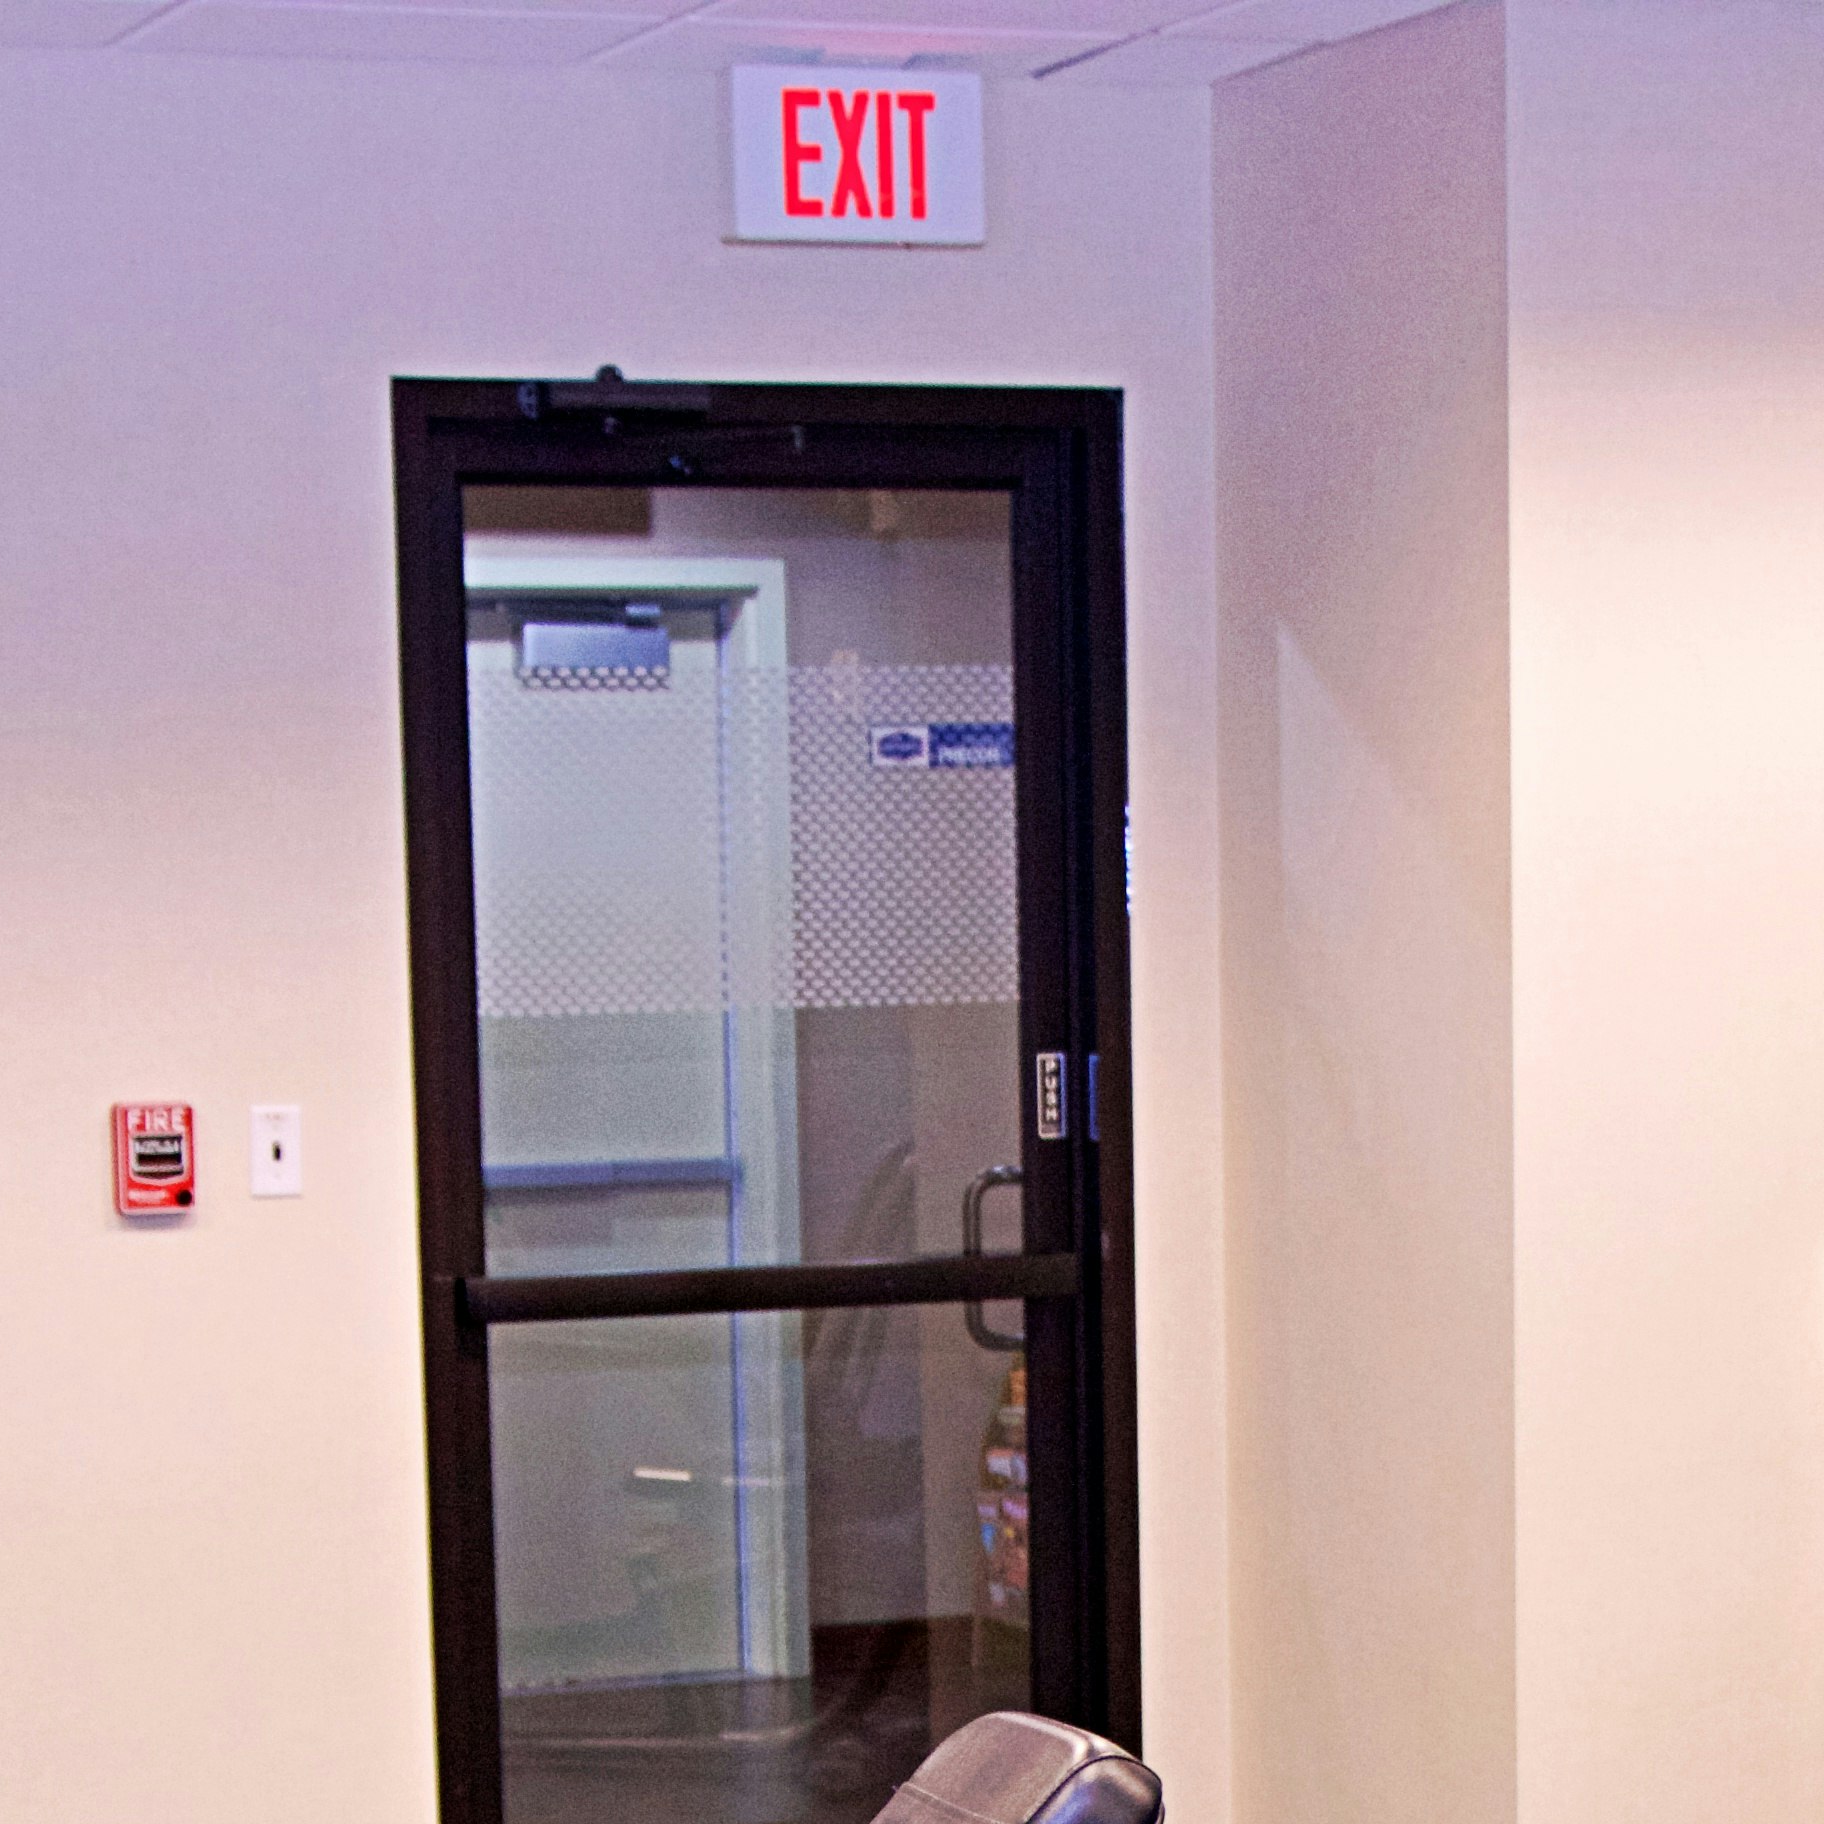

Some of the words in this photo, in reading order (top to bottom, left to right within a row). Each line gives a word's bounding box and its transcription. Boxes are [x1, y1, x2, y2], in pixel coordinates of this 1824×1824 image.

[781, 86, 936, 221] EXIT
[128, 1105, 187, 1133] FIRE
[1044, 1059, 1058, 1121] PUSH
